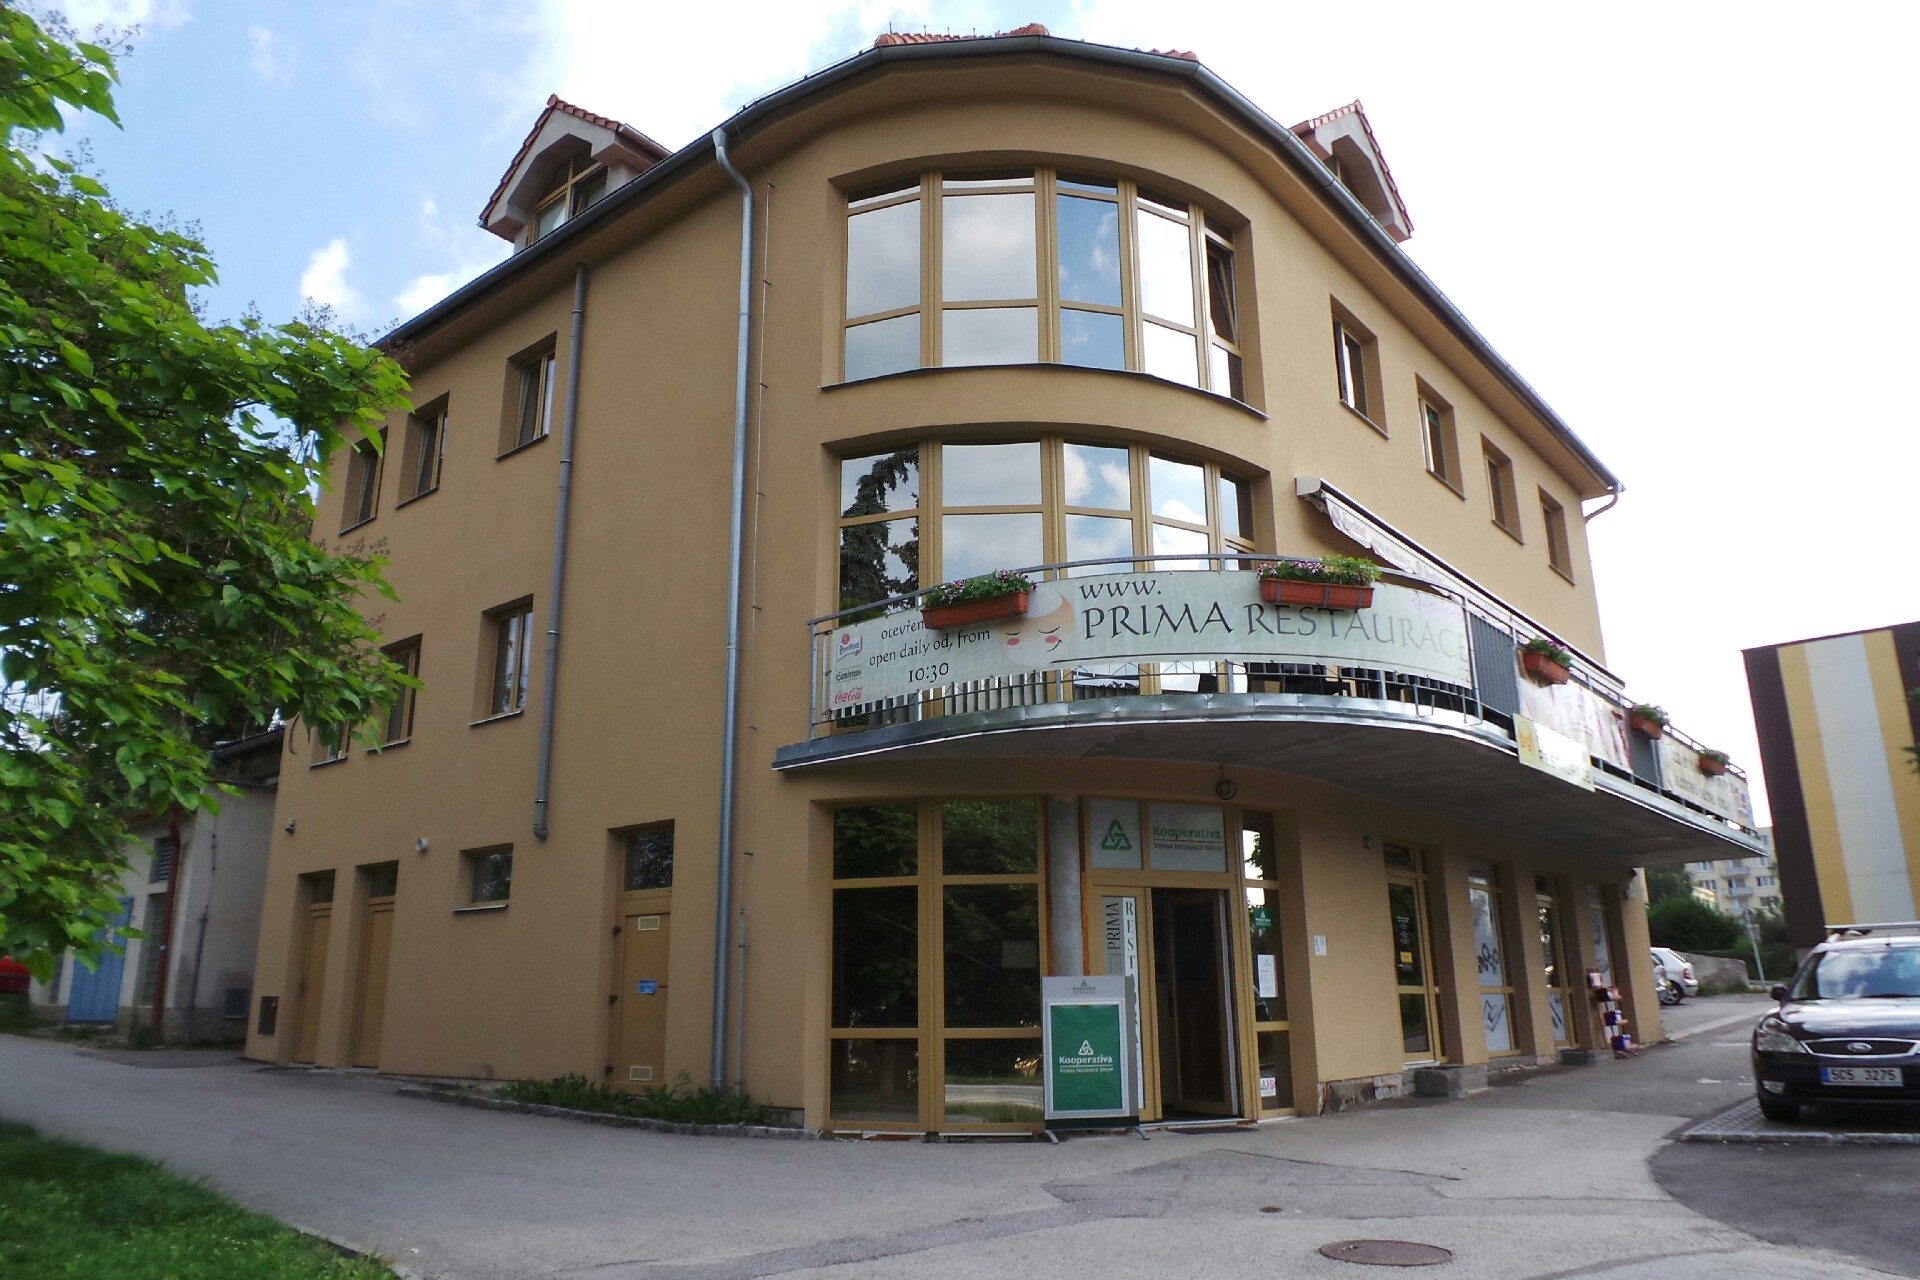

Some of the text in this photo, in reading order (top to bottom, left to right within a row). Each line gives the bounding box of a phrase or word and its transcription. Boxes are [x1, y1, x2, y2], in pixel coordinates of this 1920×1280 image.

[1079, 579, 1162, 600] www.
[881, 619, 925, 640] otevřen
[1081, 601, 1234, 640] PRIMA
[1243, 603, 1469, 663] RESTAURACE
[869, 651, 896, 668] open
[899, 639, 930, 656] daily
[957, 629, 990, 649] from
[908, 662, 949, 684] 10:30
[1152, 825, 1221, 840] Kooperativa
[1105, 902, 1121, 950] PRIMA
[1059, 1054, 1113, 1066] Kooperativa
[1864, 1069, 1896, 1081] 3275
